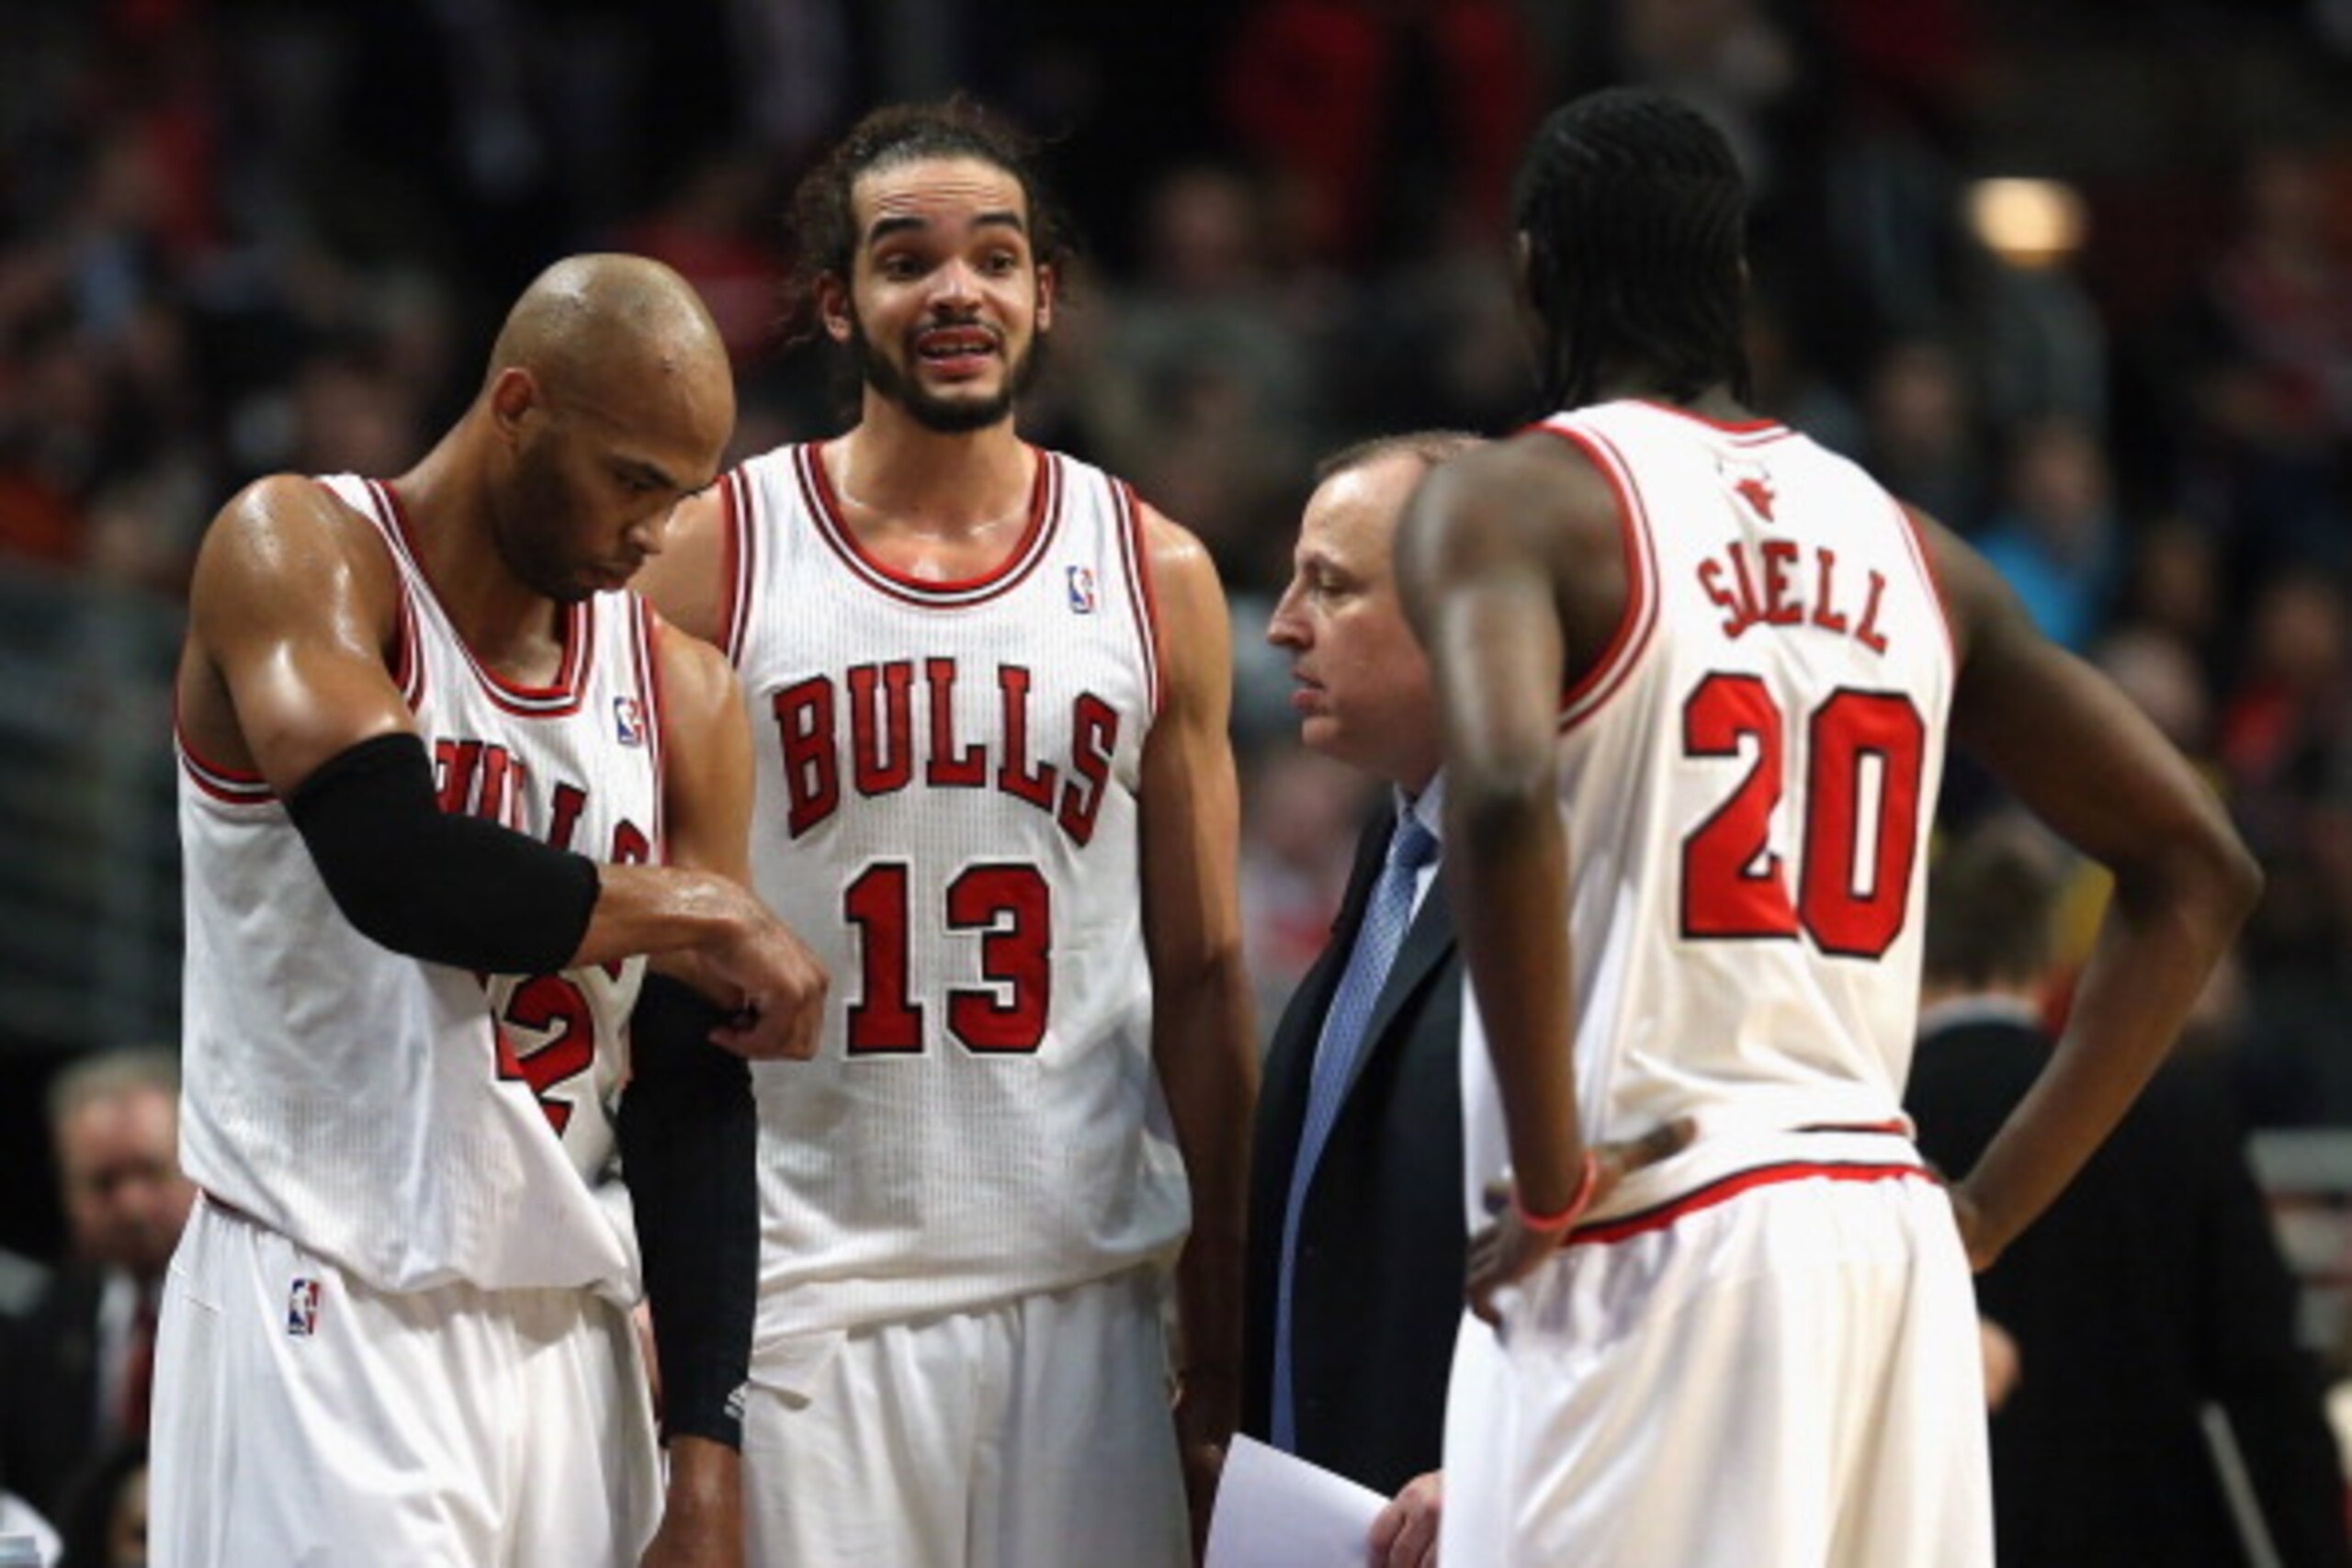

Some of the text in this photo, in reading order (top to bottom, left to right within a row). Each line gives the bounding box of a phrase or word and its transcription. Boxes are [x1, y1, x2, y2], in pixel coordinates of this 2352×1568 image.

[772, 657, 1119, 848] BULLS
[1679, 671, 1927, 961] 20
[842, 862, 1051, 1055] 13
